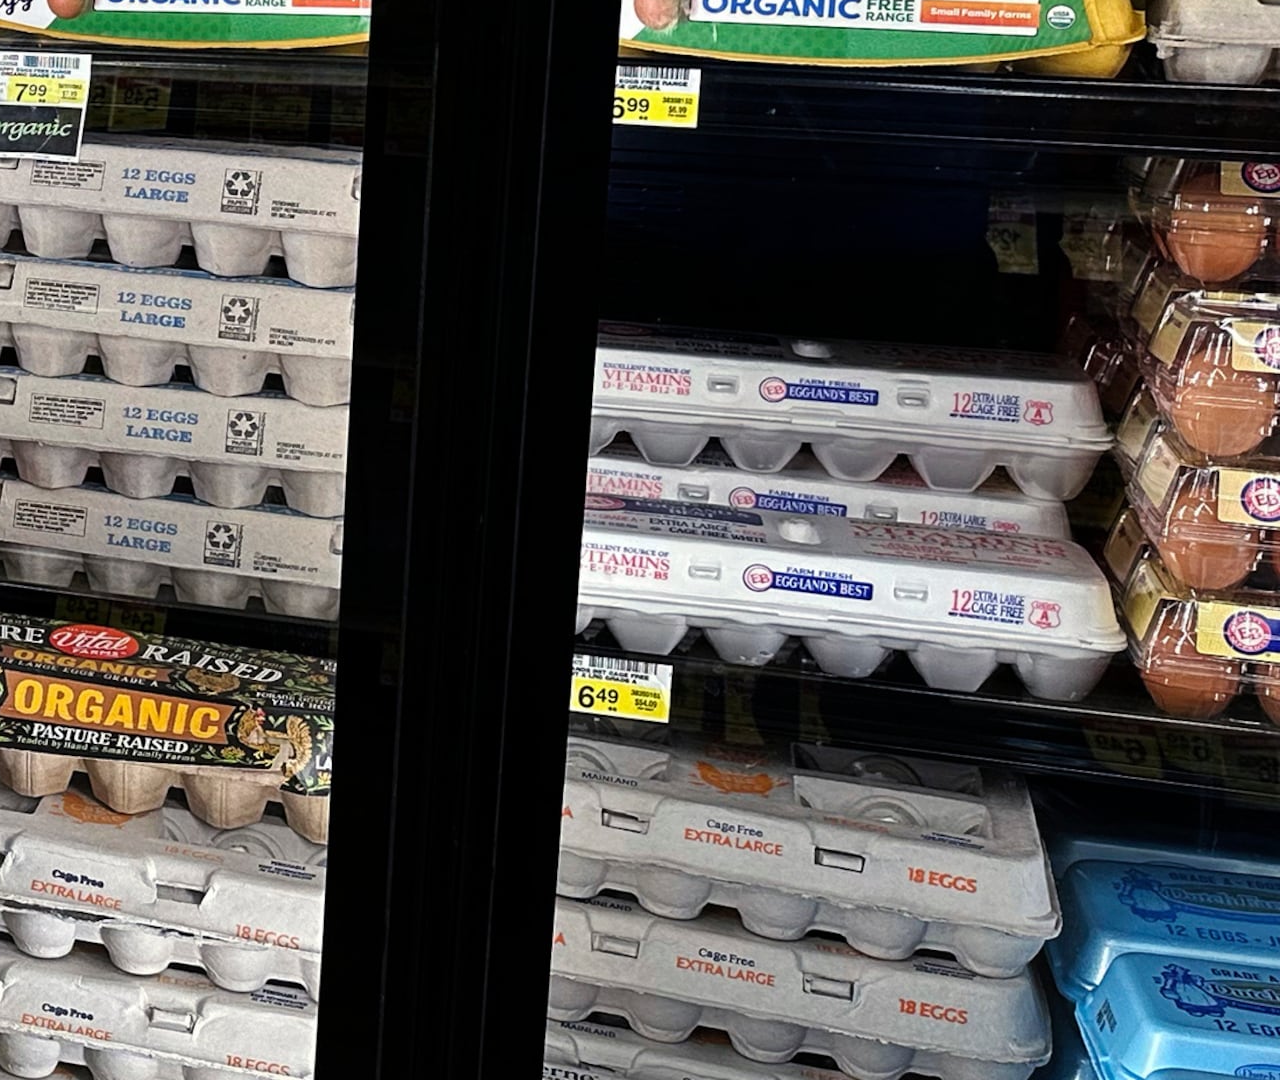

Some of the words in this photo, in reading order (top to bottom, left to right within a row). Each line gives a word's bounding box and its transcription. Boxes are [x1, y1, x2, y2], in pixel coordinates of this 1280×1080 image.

[121, 168, 141, 181] 12
[145, 169, 196, 186] EGGS
[124, 186, 189, 203] LARGE
[603, 370, 692, 388] VITAMINS
[800, 378, 826, 386] FARM
[848, 390, 876, 403] BEST
[952, 589, 972, 612] 12
[971, 604, 998, 616] CAGE
[1000, 606, 1024, 618] FREE
[14, 678, 222, 741] ORGANIC
[684, 828, 733, 851] EXTRA
[736, 835, 783, 857] LARGE
[907, 867, 926, 885] 18
[929, 870, 977, 894] EGGS
[31, 880, 81, 902] EXTRA
[83, 888, 122, 911] LARGE
[1166, 924, 1187, 936] 12
[1197, 928, 1249, 944] EGGS
